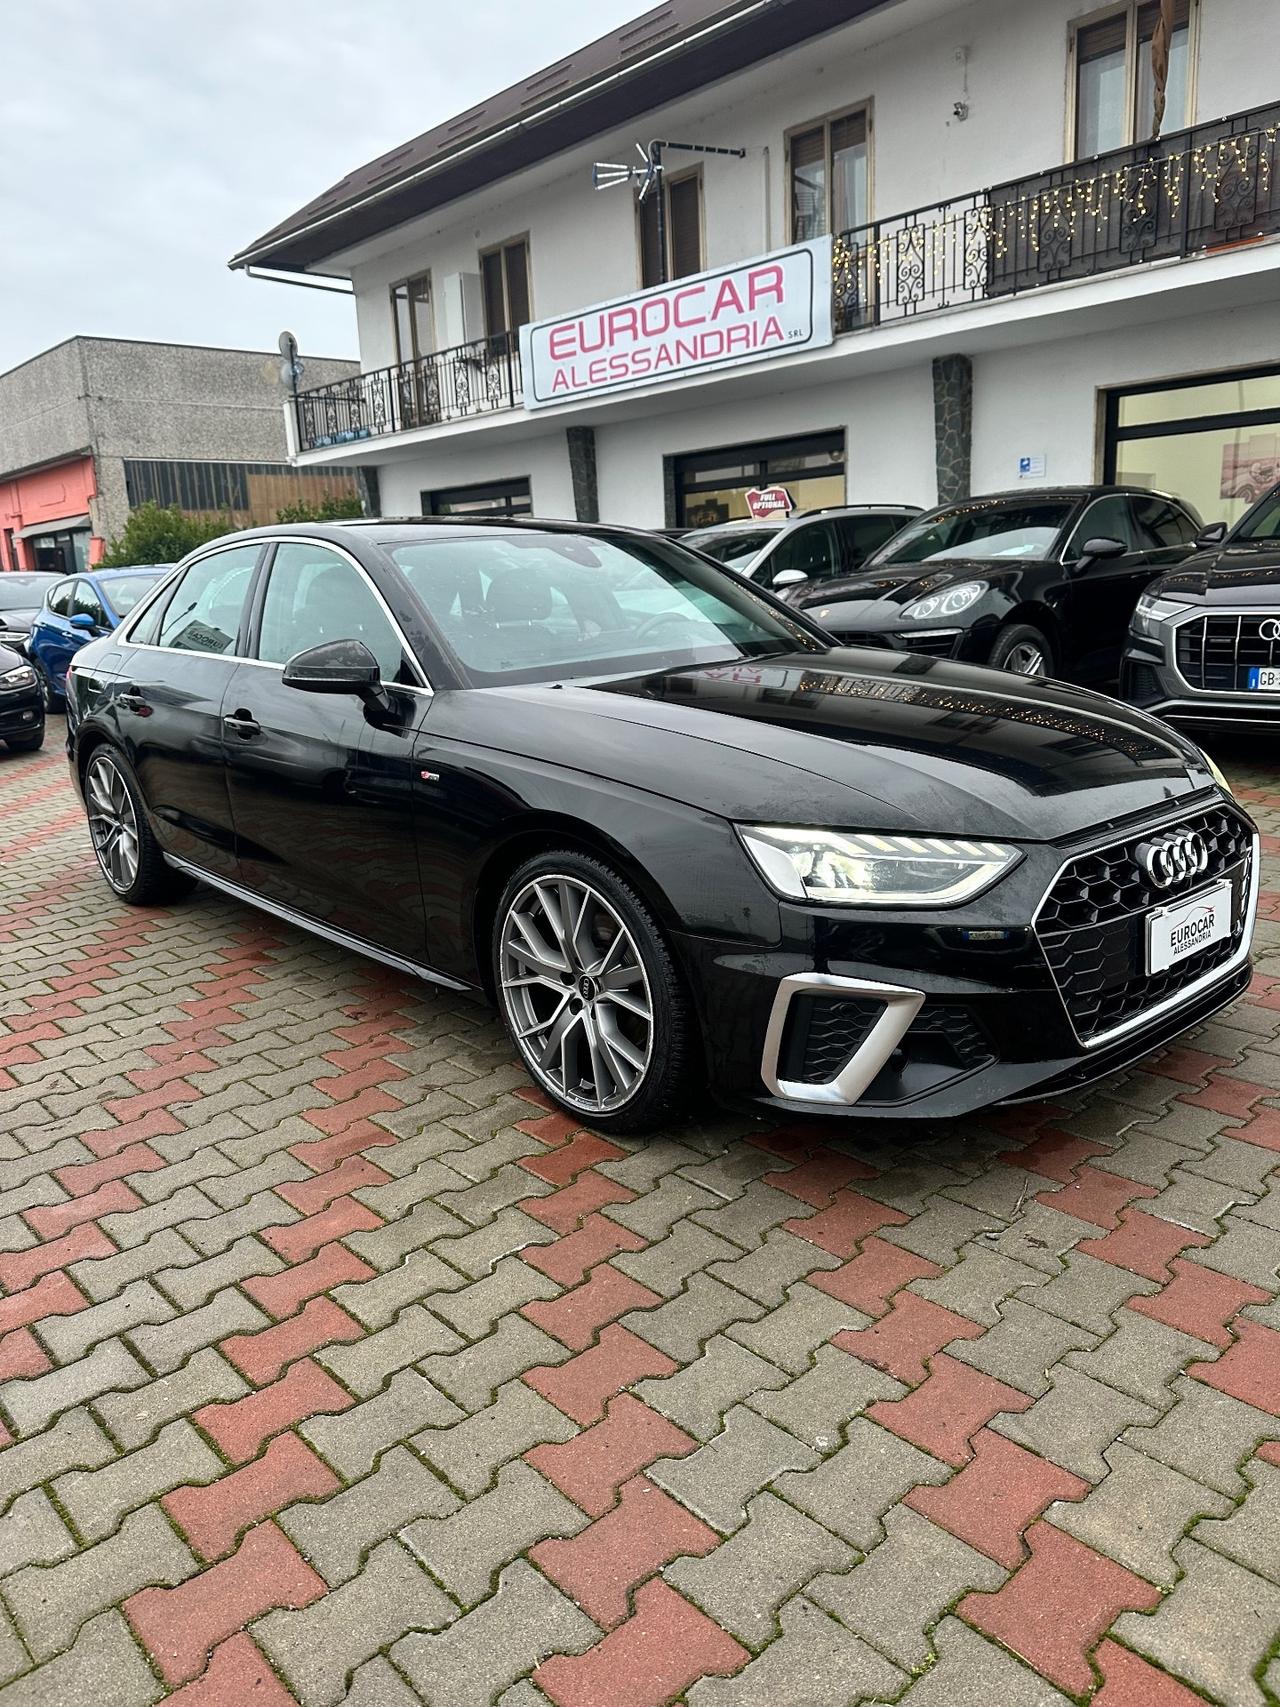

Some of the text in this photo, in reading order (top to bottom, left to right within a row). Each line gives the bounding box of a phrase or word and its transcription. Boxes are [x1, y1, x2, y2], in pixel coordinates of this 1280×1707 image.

[549, 265, 784, 361] EUROCAR
[552, 316, 803, 393] ALESSANDRIA SRL
[752, 500, 786, 510] OPTIONAL
[760, 493, 776, 501] FULL
[1170, 913, 1215, 947] EUROCAR
[1173, 930, 1212, 956] ALESSANDRIA
